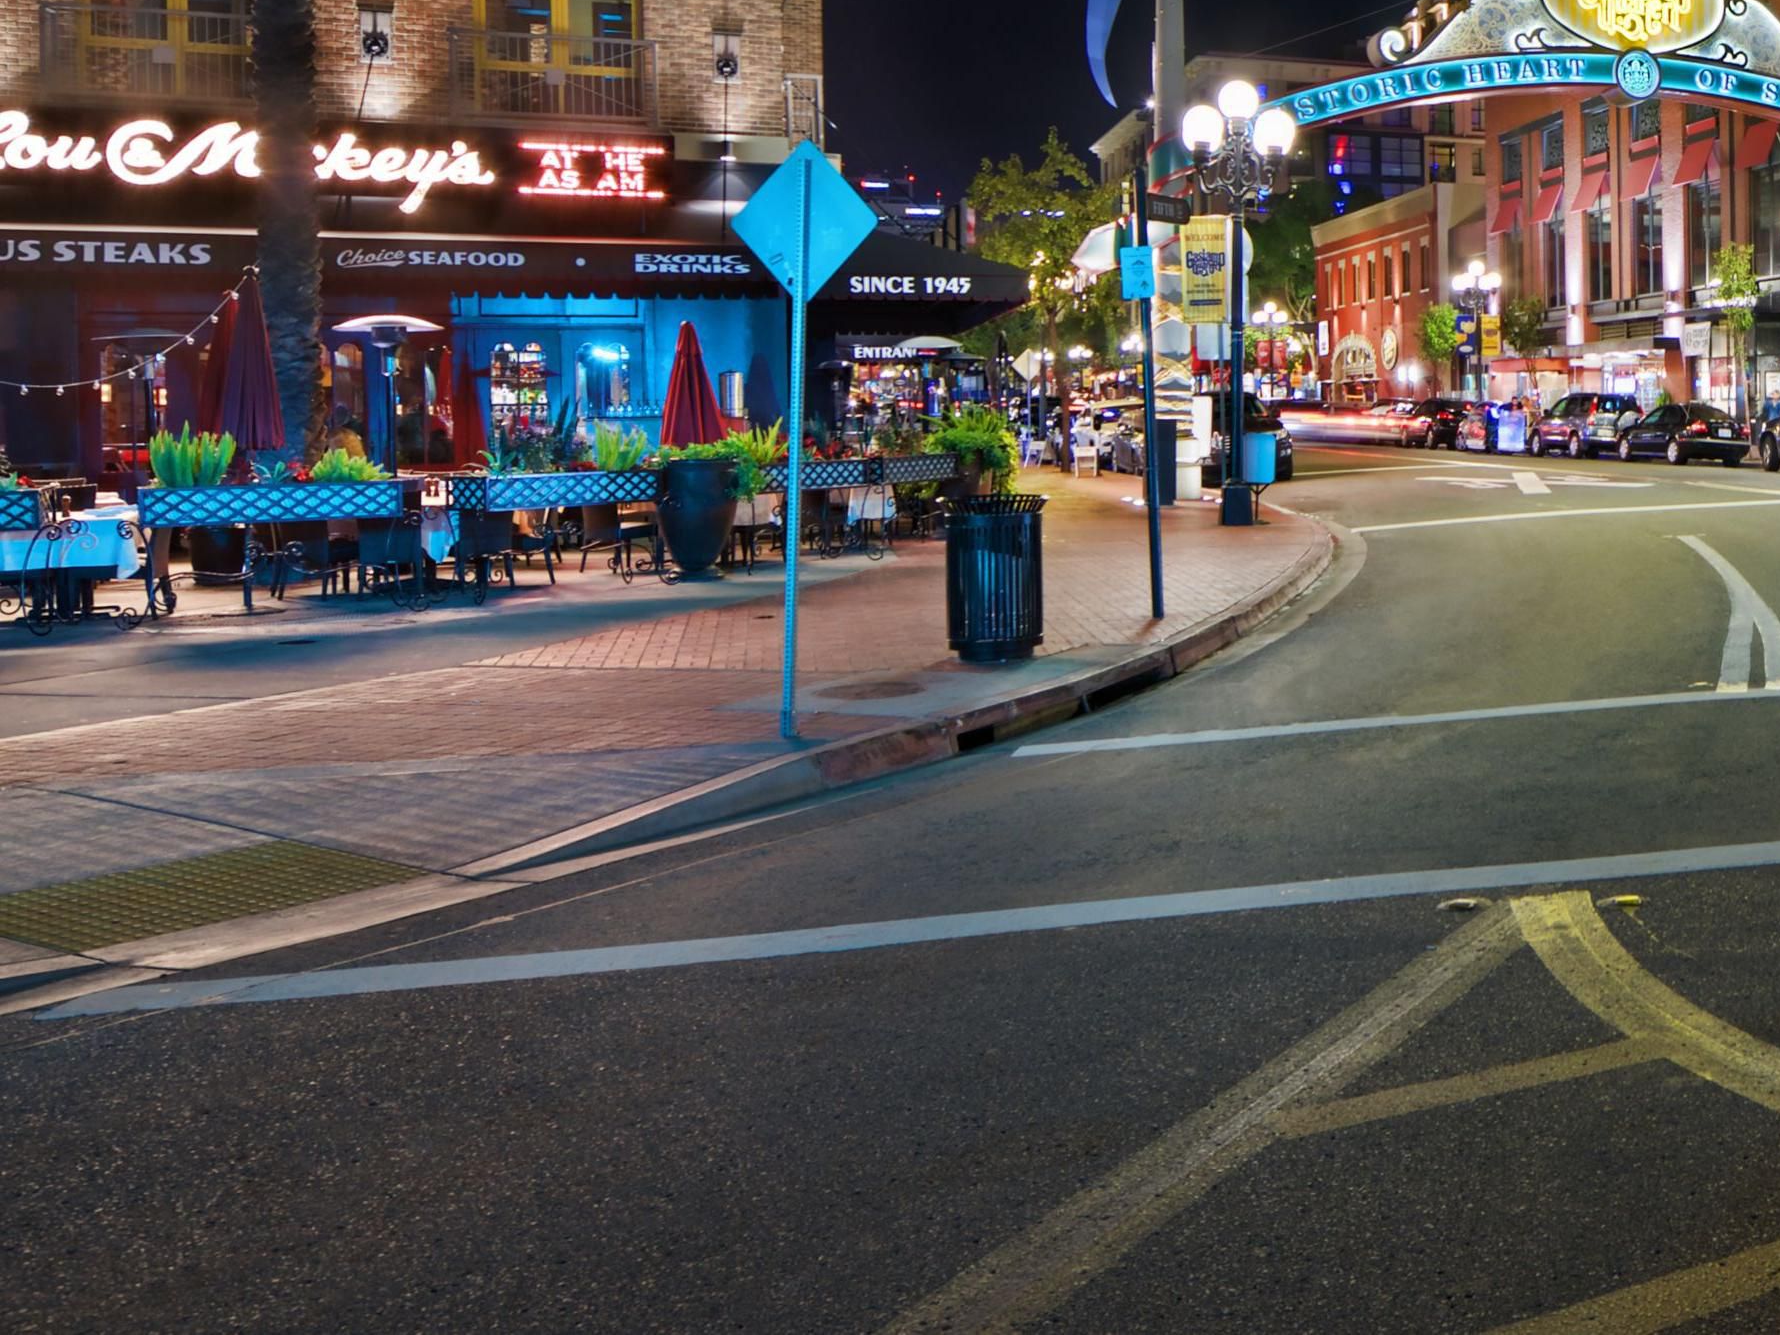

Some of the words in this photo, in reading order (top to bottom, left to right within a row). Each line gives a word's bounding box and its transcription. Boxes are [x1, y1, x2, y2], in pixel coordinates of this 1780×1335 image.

[1293, 68, 1441, 119] STORIC
[1463, 58, 1585, 85] HEART
[1695, 69, 1737, 92] OF
[106, 120, 495, 214] Mkey's
[538, 169, 579, 188] AS
[597, 172, 644, 191] AM
[1185, 233, 1224, 241] WELCOME
[53, 241, 211, 265] STEAKS
[336, 249, 405, 269] Choice
[408, 251, 525, 266] SEAFOOD
[634, 254, 742, 264] EXOTIC
[634, 264, 750, 274] DRINKS
[850, 276, 915, 294] SINCE
[923, 277, 971, 294] 1945
